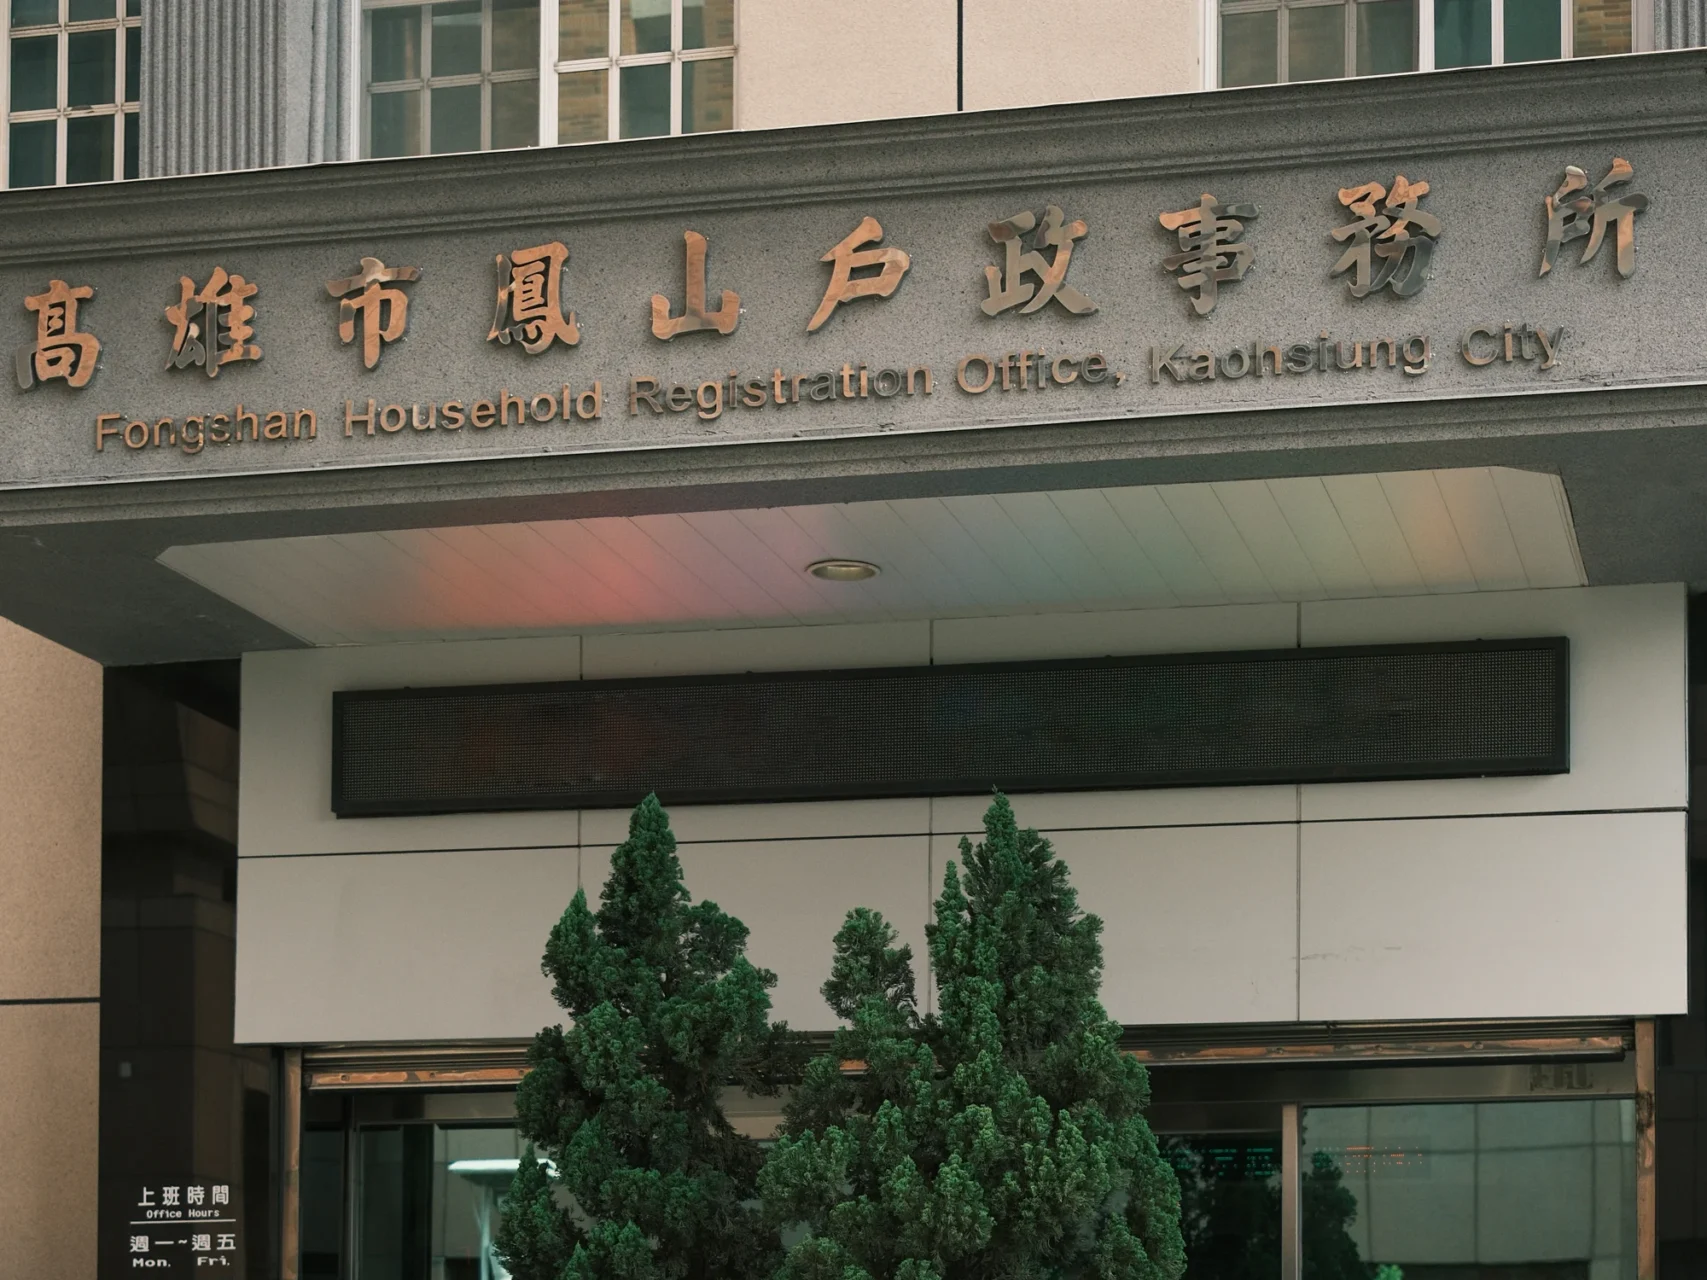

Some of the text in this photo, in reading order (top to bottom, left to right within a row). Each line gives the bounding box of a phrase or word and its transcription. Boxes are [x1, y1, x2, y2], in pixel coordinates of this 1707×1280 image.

[94, 321, 1566, 454] Fongshan Household Registration Office, Kaohsiung City
[138, 1185, 229, 1206] 上班時間
[146, 1208, 220, 1219] Office Hours
[133, 1256, 230, 1268] Mon. Fri.
